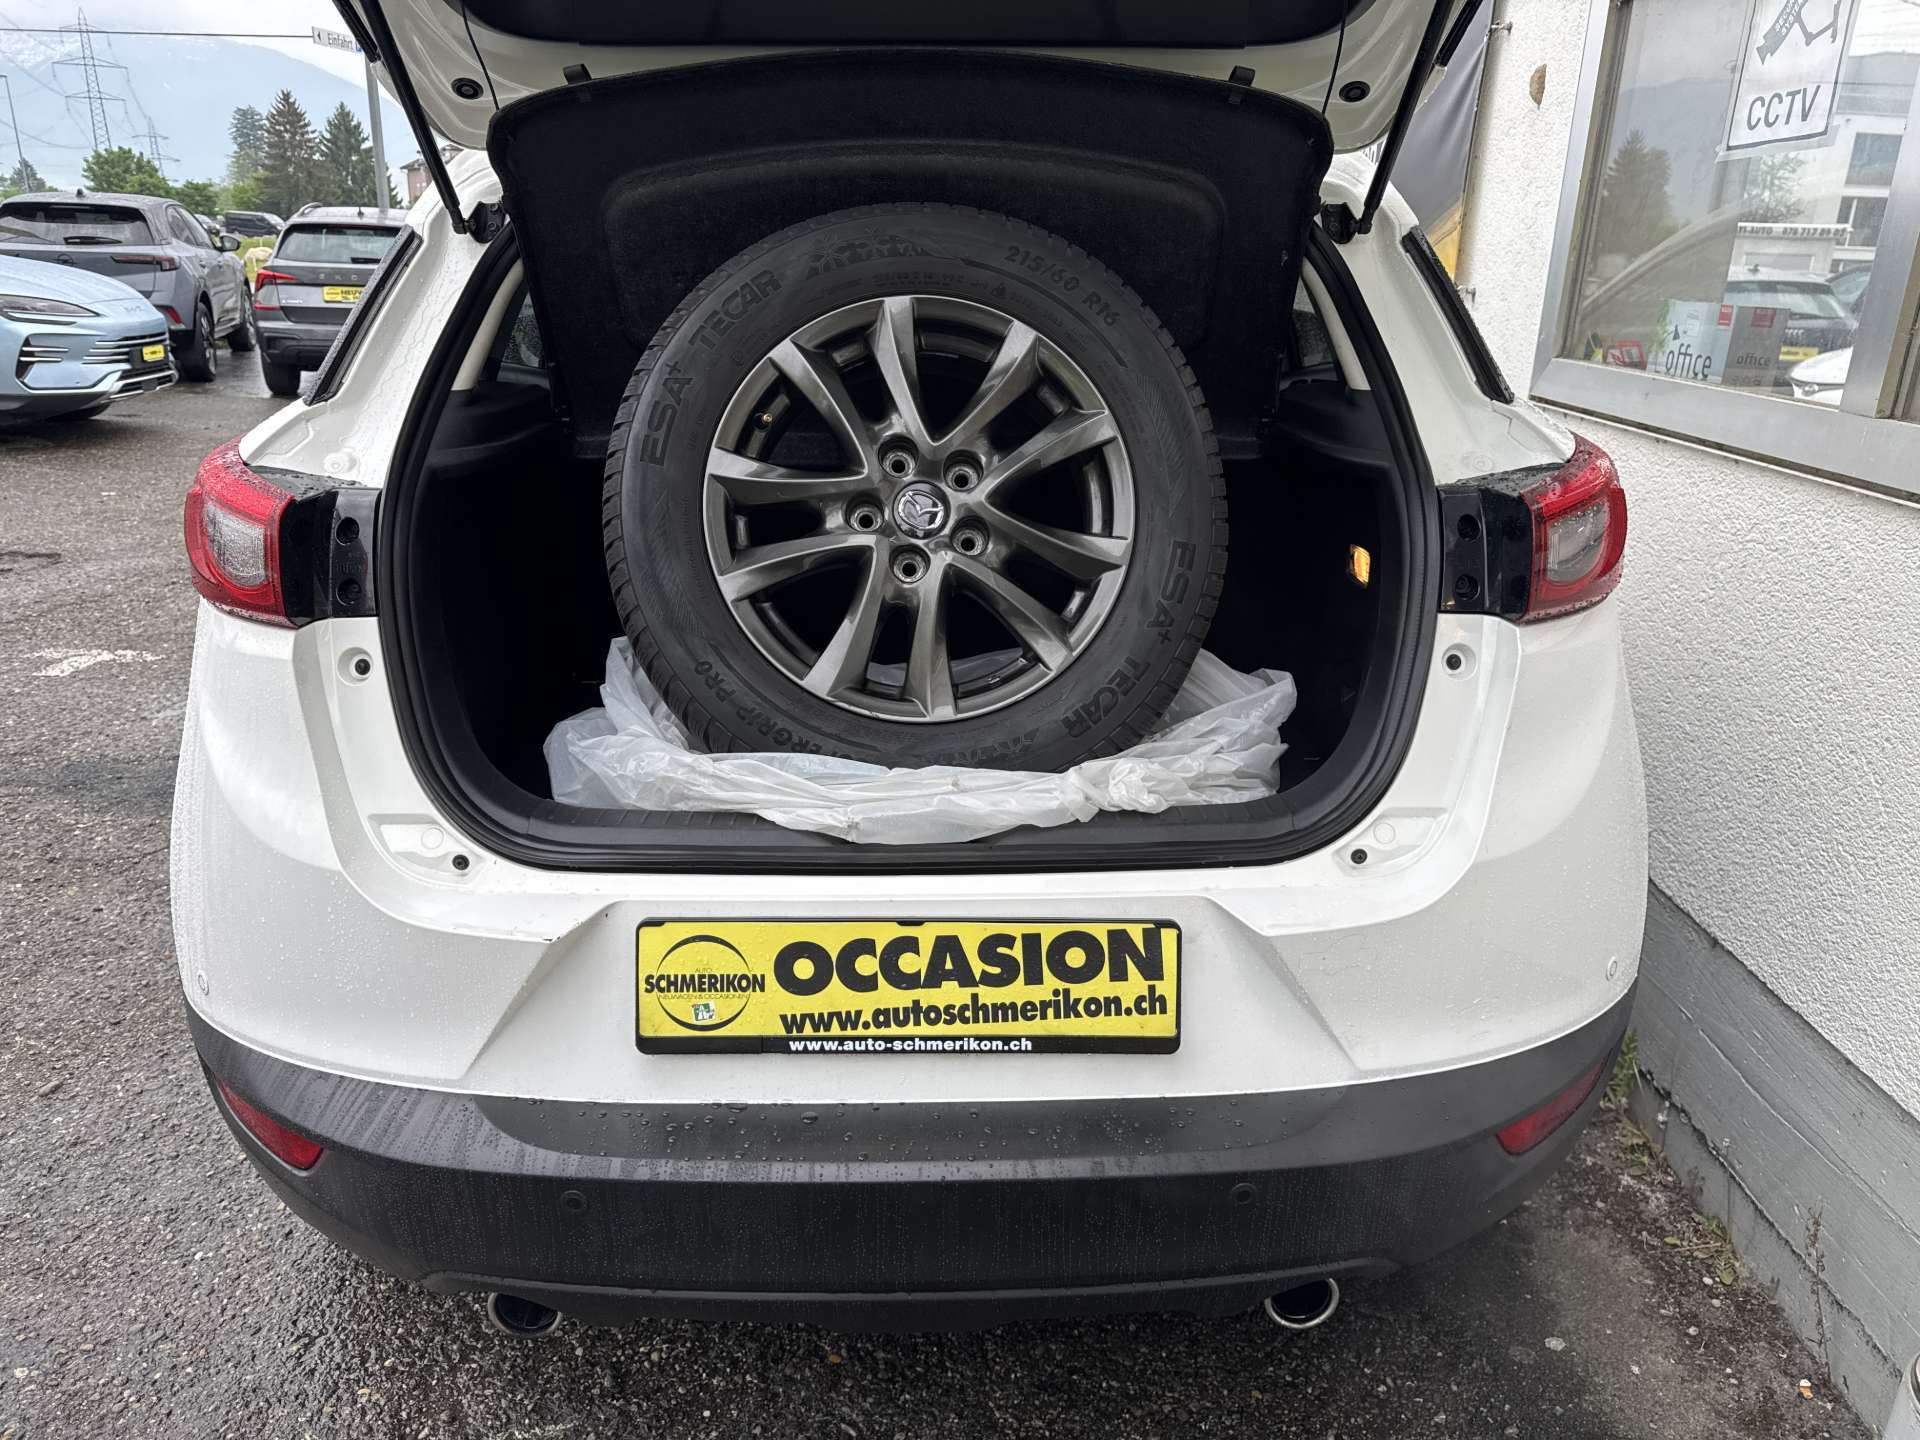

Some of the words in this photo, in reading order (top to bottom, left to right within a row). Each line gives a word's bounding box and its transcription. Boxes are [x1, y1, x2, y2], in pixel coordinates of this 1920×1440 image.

[1746, 84, 1821, 131] CCTV
[687, 269, 783, 350] TECAR
[1003, 245, 1081, 292] 215/60
[1081, 291, 1121, 327] R16
[1665, 342, 1712, 378] office
[1736, 352, 1771, 367] office
[694, 660, 736, 703] PRO
[1060, 655, 1151, 738] TECAR
[644, 973, 766, 994] SCHMERIKON
[773, 927, 1165, 996] OCCASION
[779, 984, 1168, 1034] www.autoschmerikon.ch
[788, 1037, 1033, 1051] www.auto-schmerikon.ch
